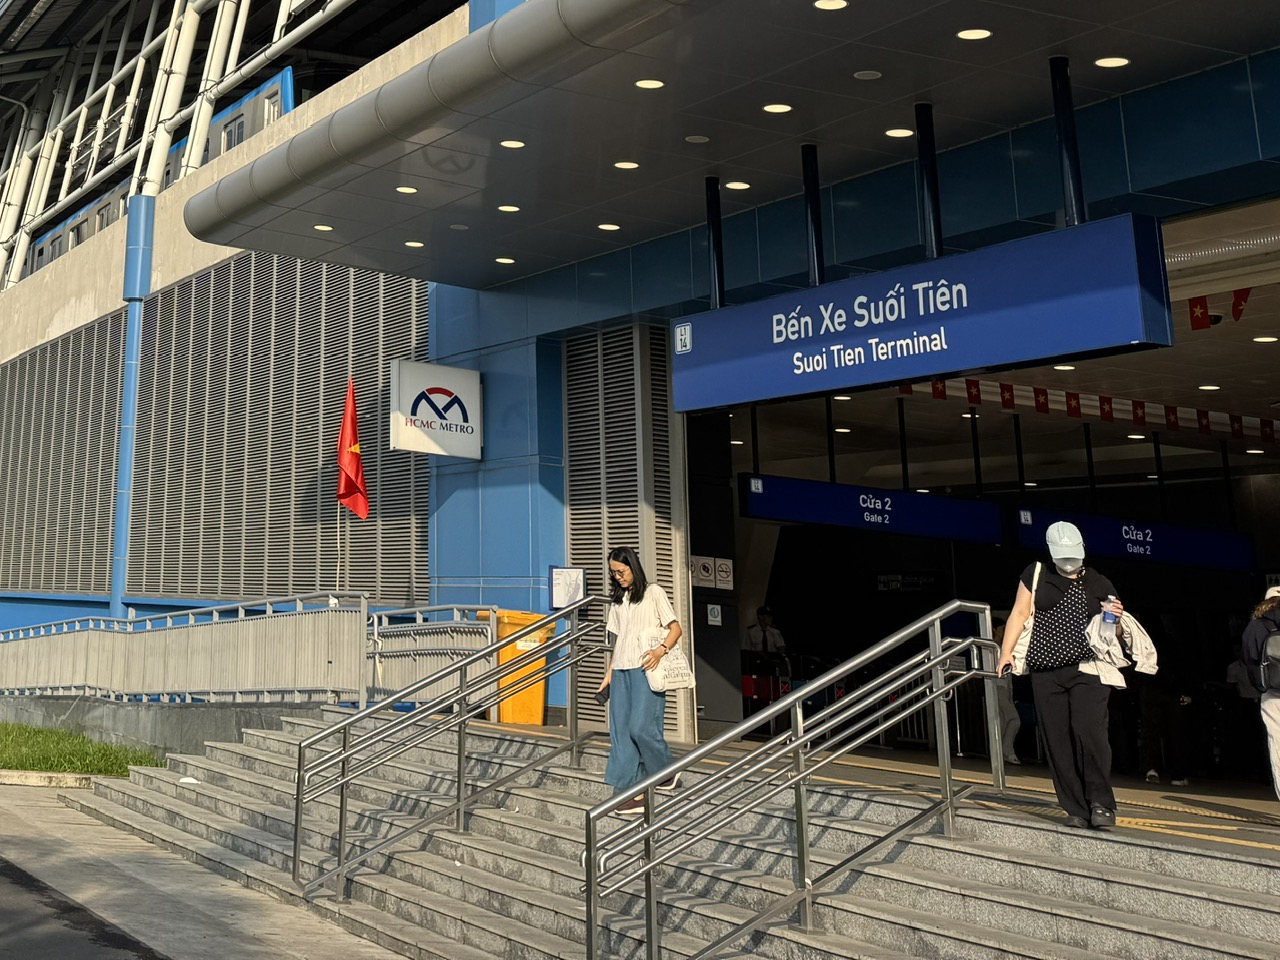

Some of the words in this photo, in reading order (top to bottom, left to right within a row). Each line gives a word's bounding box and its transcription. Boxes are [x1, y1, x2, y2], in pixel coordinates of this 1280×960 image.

[772, 305, 813, 344] Bến
[819, 302, 847, 336] Xe
[853, 283, 907, 328] Suối
[912, 279, 968, 316] Tiên
[679, 337, 688, 350] 14
[793, 347, 827, 375] Suoi
[830, 344, 865, 368] Tien
[868, 326, 948, 362] Terminal
[405, 417, 437, 430] HCMC
[439, 422, 474, 435] METRO
[859, 494, 882, 509] Cửa
[884, 497, 892, 510] 2
[864, 512, 882, 523] Gate
[884, 514, 890, 524] 2
[1122, 525, 1144, 541] Cửa
[1145, 529, 1153, 542] 2
[1127, 543, 1145, 554] Gate
[1145, 545, 1151, 555] 2
